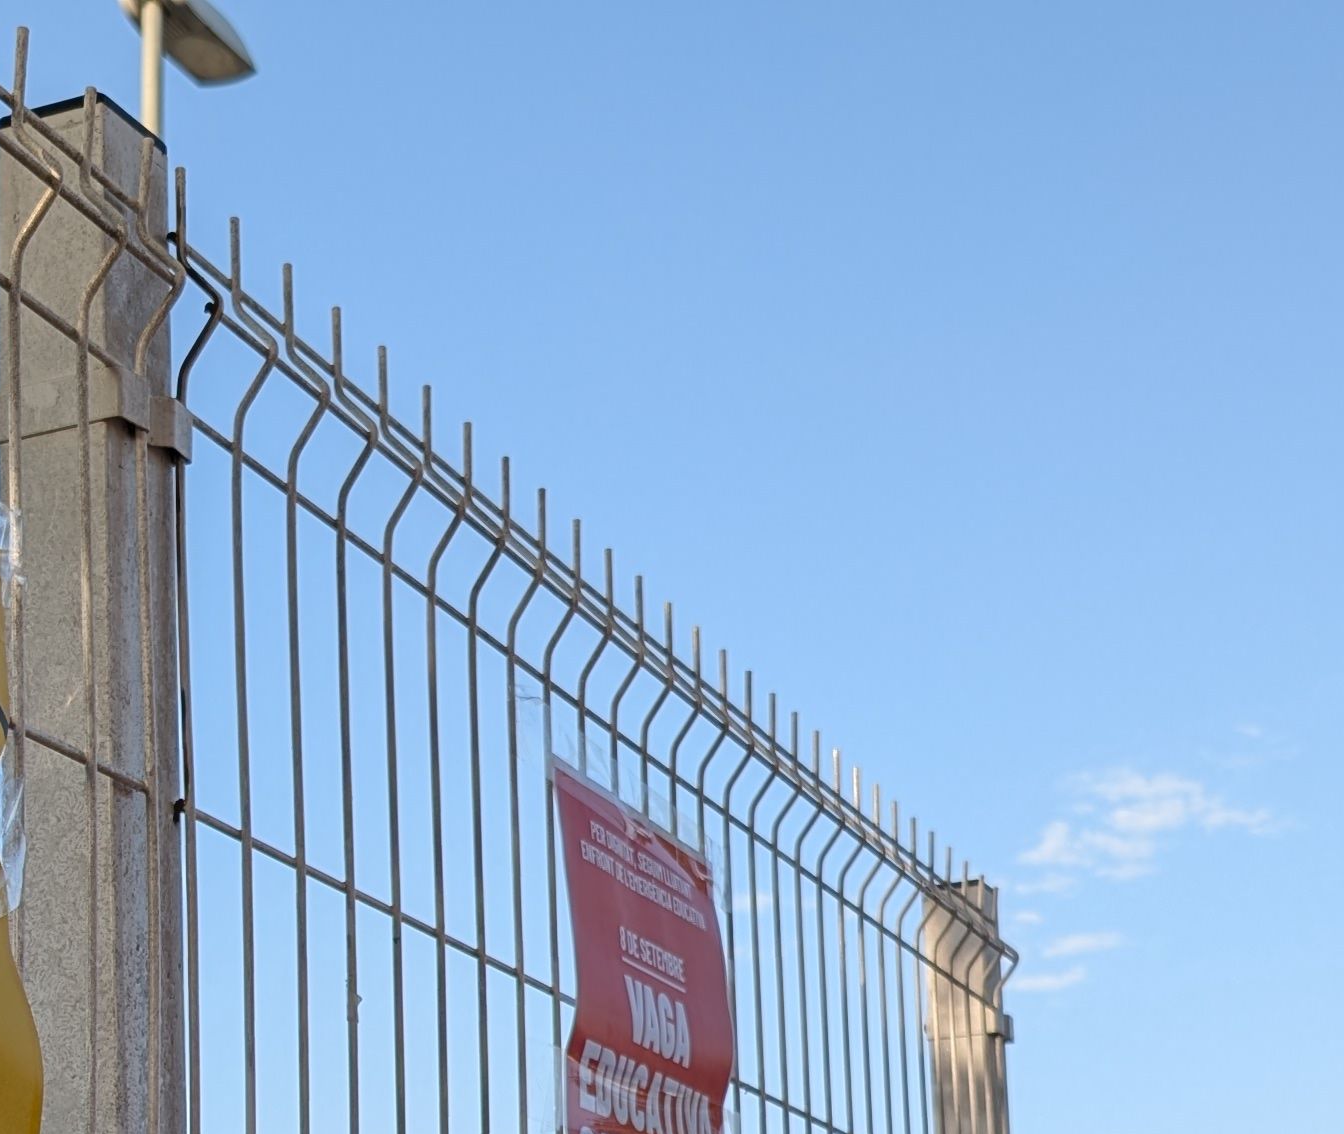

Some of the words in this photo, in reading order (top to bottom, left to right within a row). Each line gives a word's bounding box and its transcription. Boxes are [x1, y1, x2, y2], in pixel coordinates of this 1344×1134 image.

[619, 926, 626, 951] 8
[627, 930, 639, 959] DE
[624, 974, 690, 1068] VAGA
